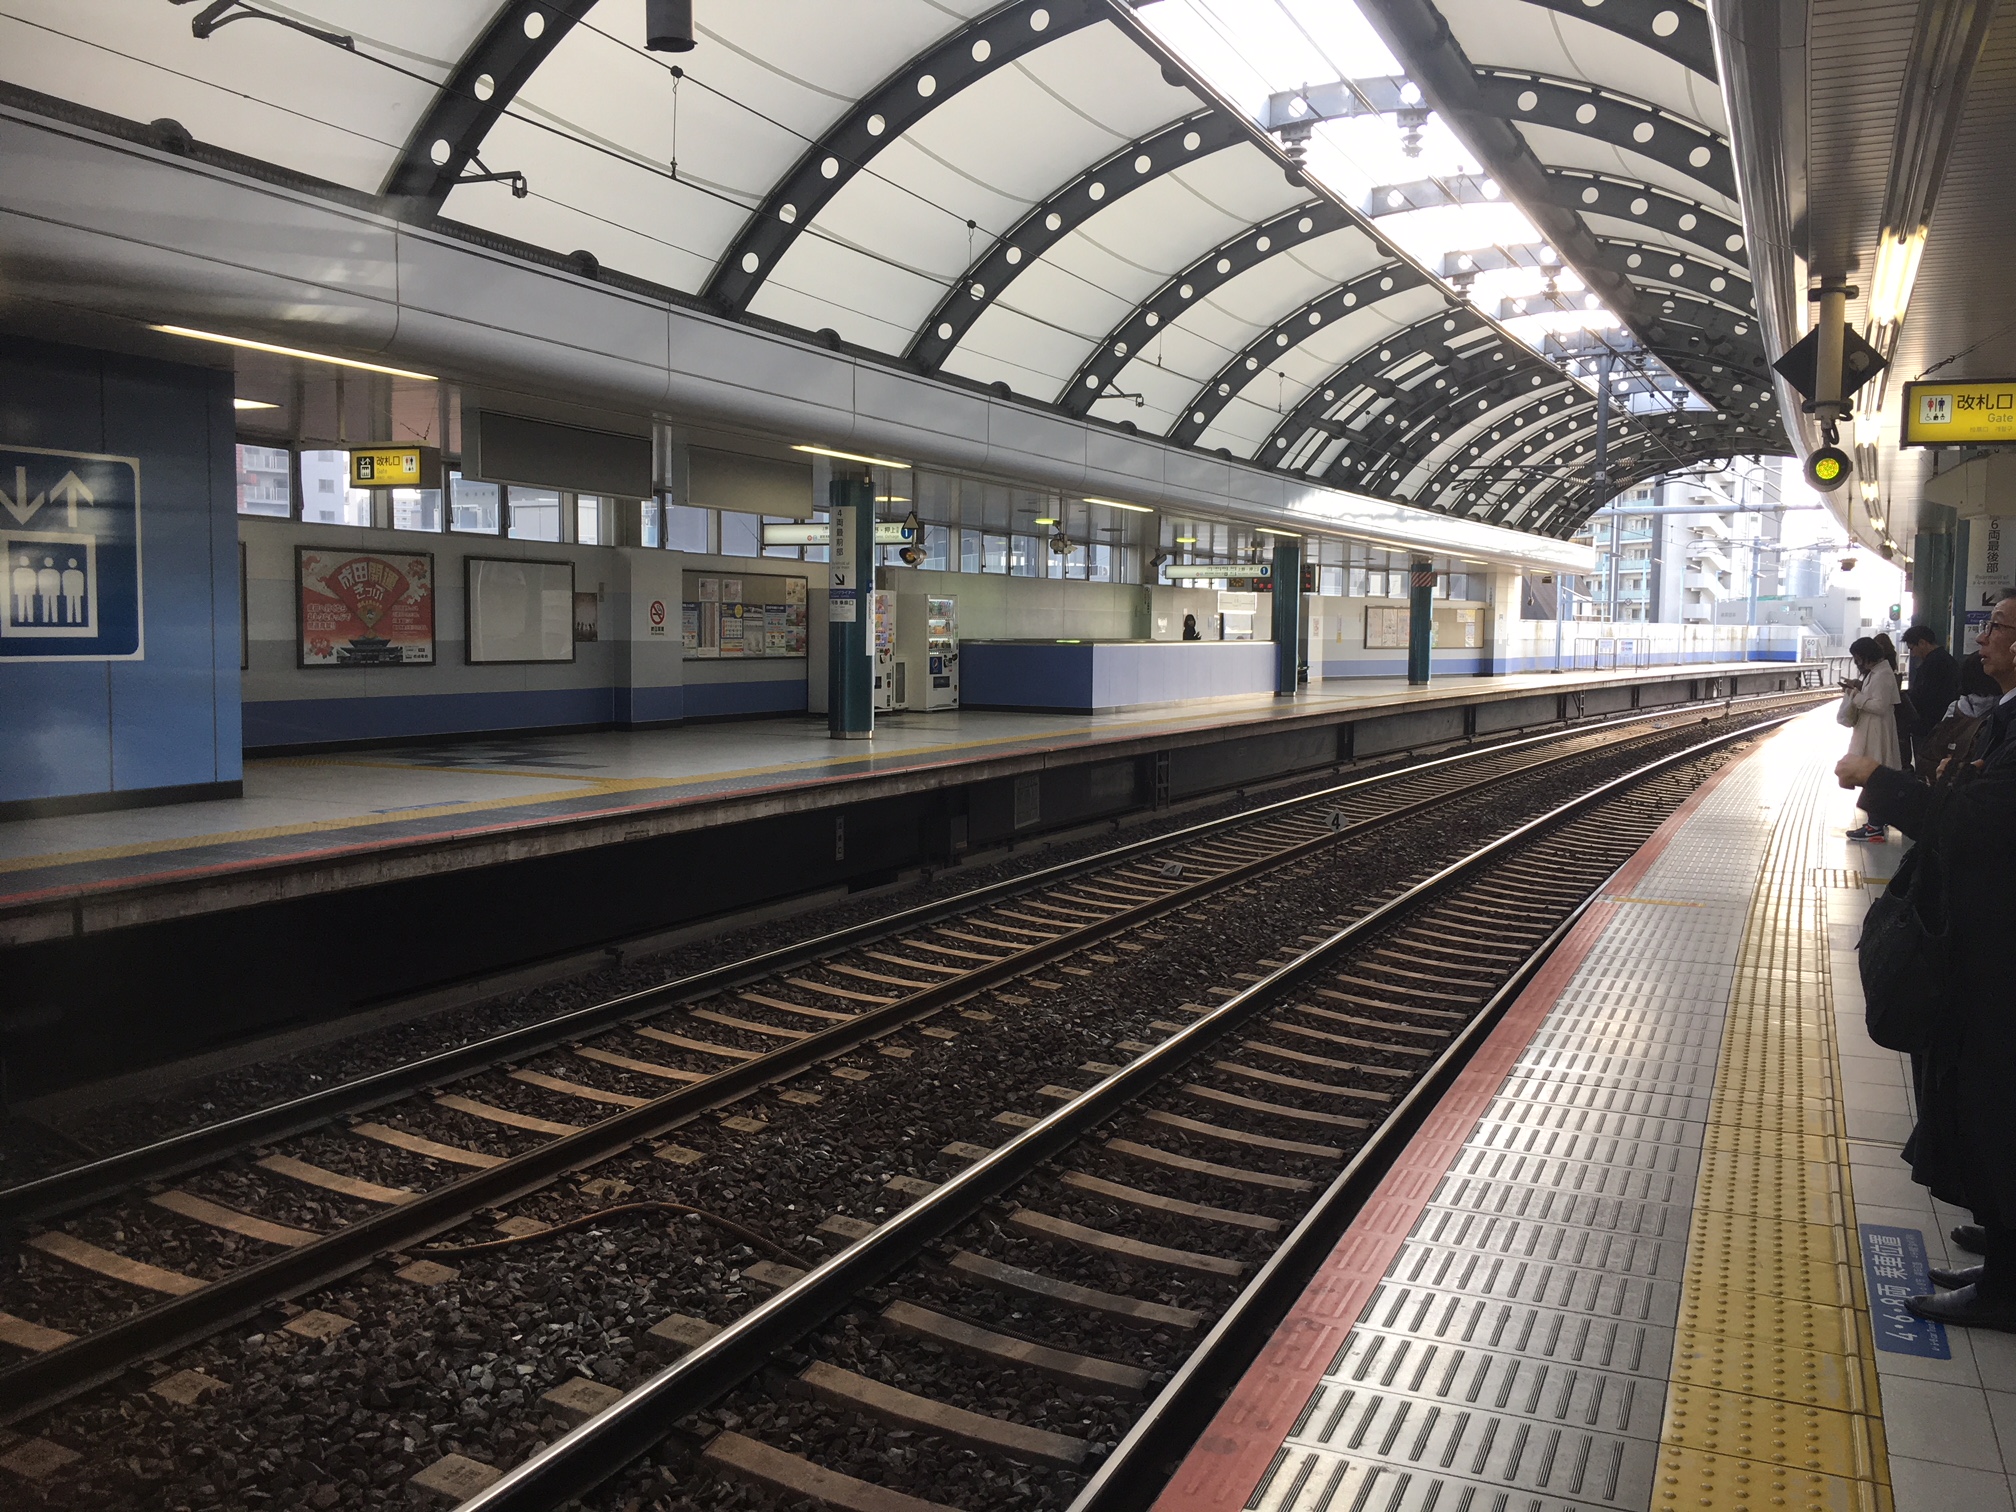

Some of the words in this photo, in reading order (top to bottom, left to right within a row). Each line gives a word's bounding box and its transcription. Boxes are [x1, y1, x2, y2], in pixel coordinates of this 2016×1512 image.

[1957, 394, 2013, 410] 改札口
[1987, 413, 2014, 423] Gate
[376, 456, 400, 466] 改札口
[1332, 813, 1341, 829] 4
[1869, 1234, 1908, 1280] 乗車位置
